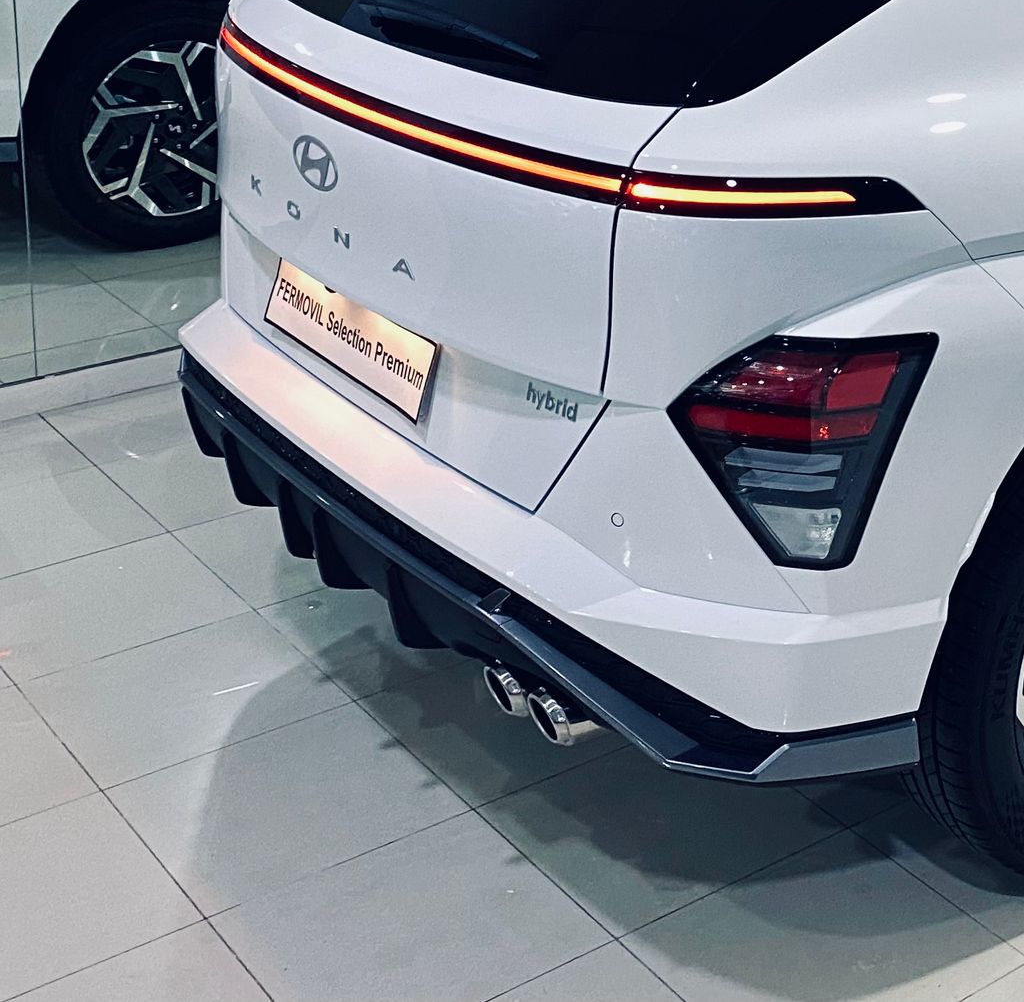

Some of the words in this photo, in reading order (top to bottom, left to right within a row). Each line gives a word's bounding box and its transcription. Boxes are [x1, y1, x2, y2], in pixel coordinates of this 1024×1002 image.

[250, 173, 416, 281] KONA
[276, 277, 324, 327] FERMOVIL
[326, 310, 372, 358] Selection
[374, 341, 424, 391] Premium
[526, 381, 579, 423] hybrid
